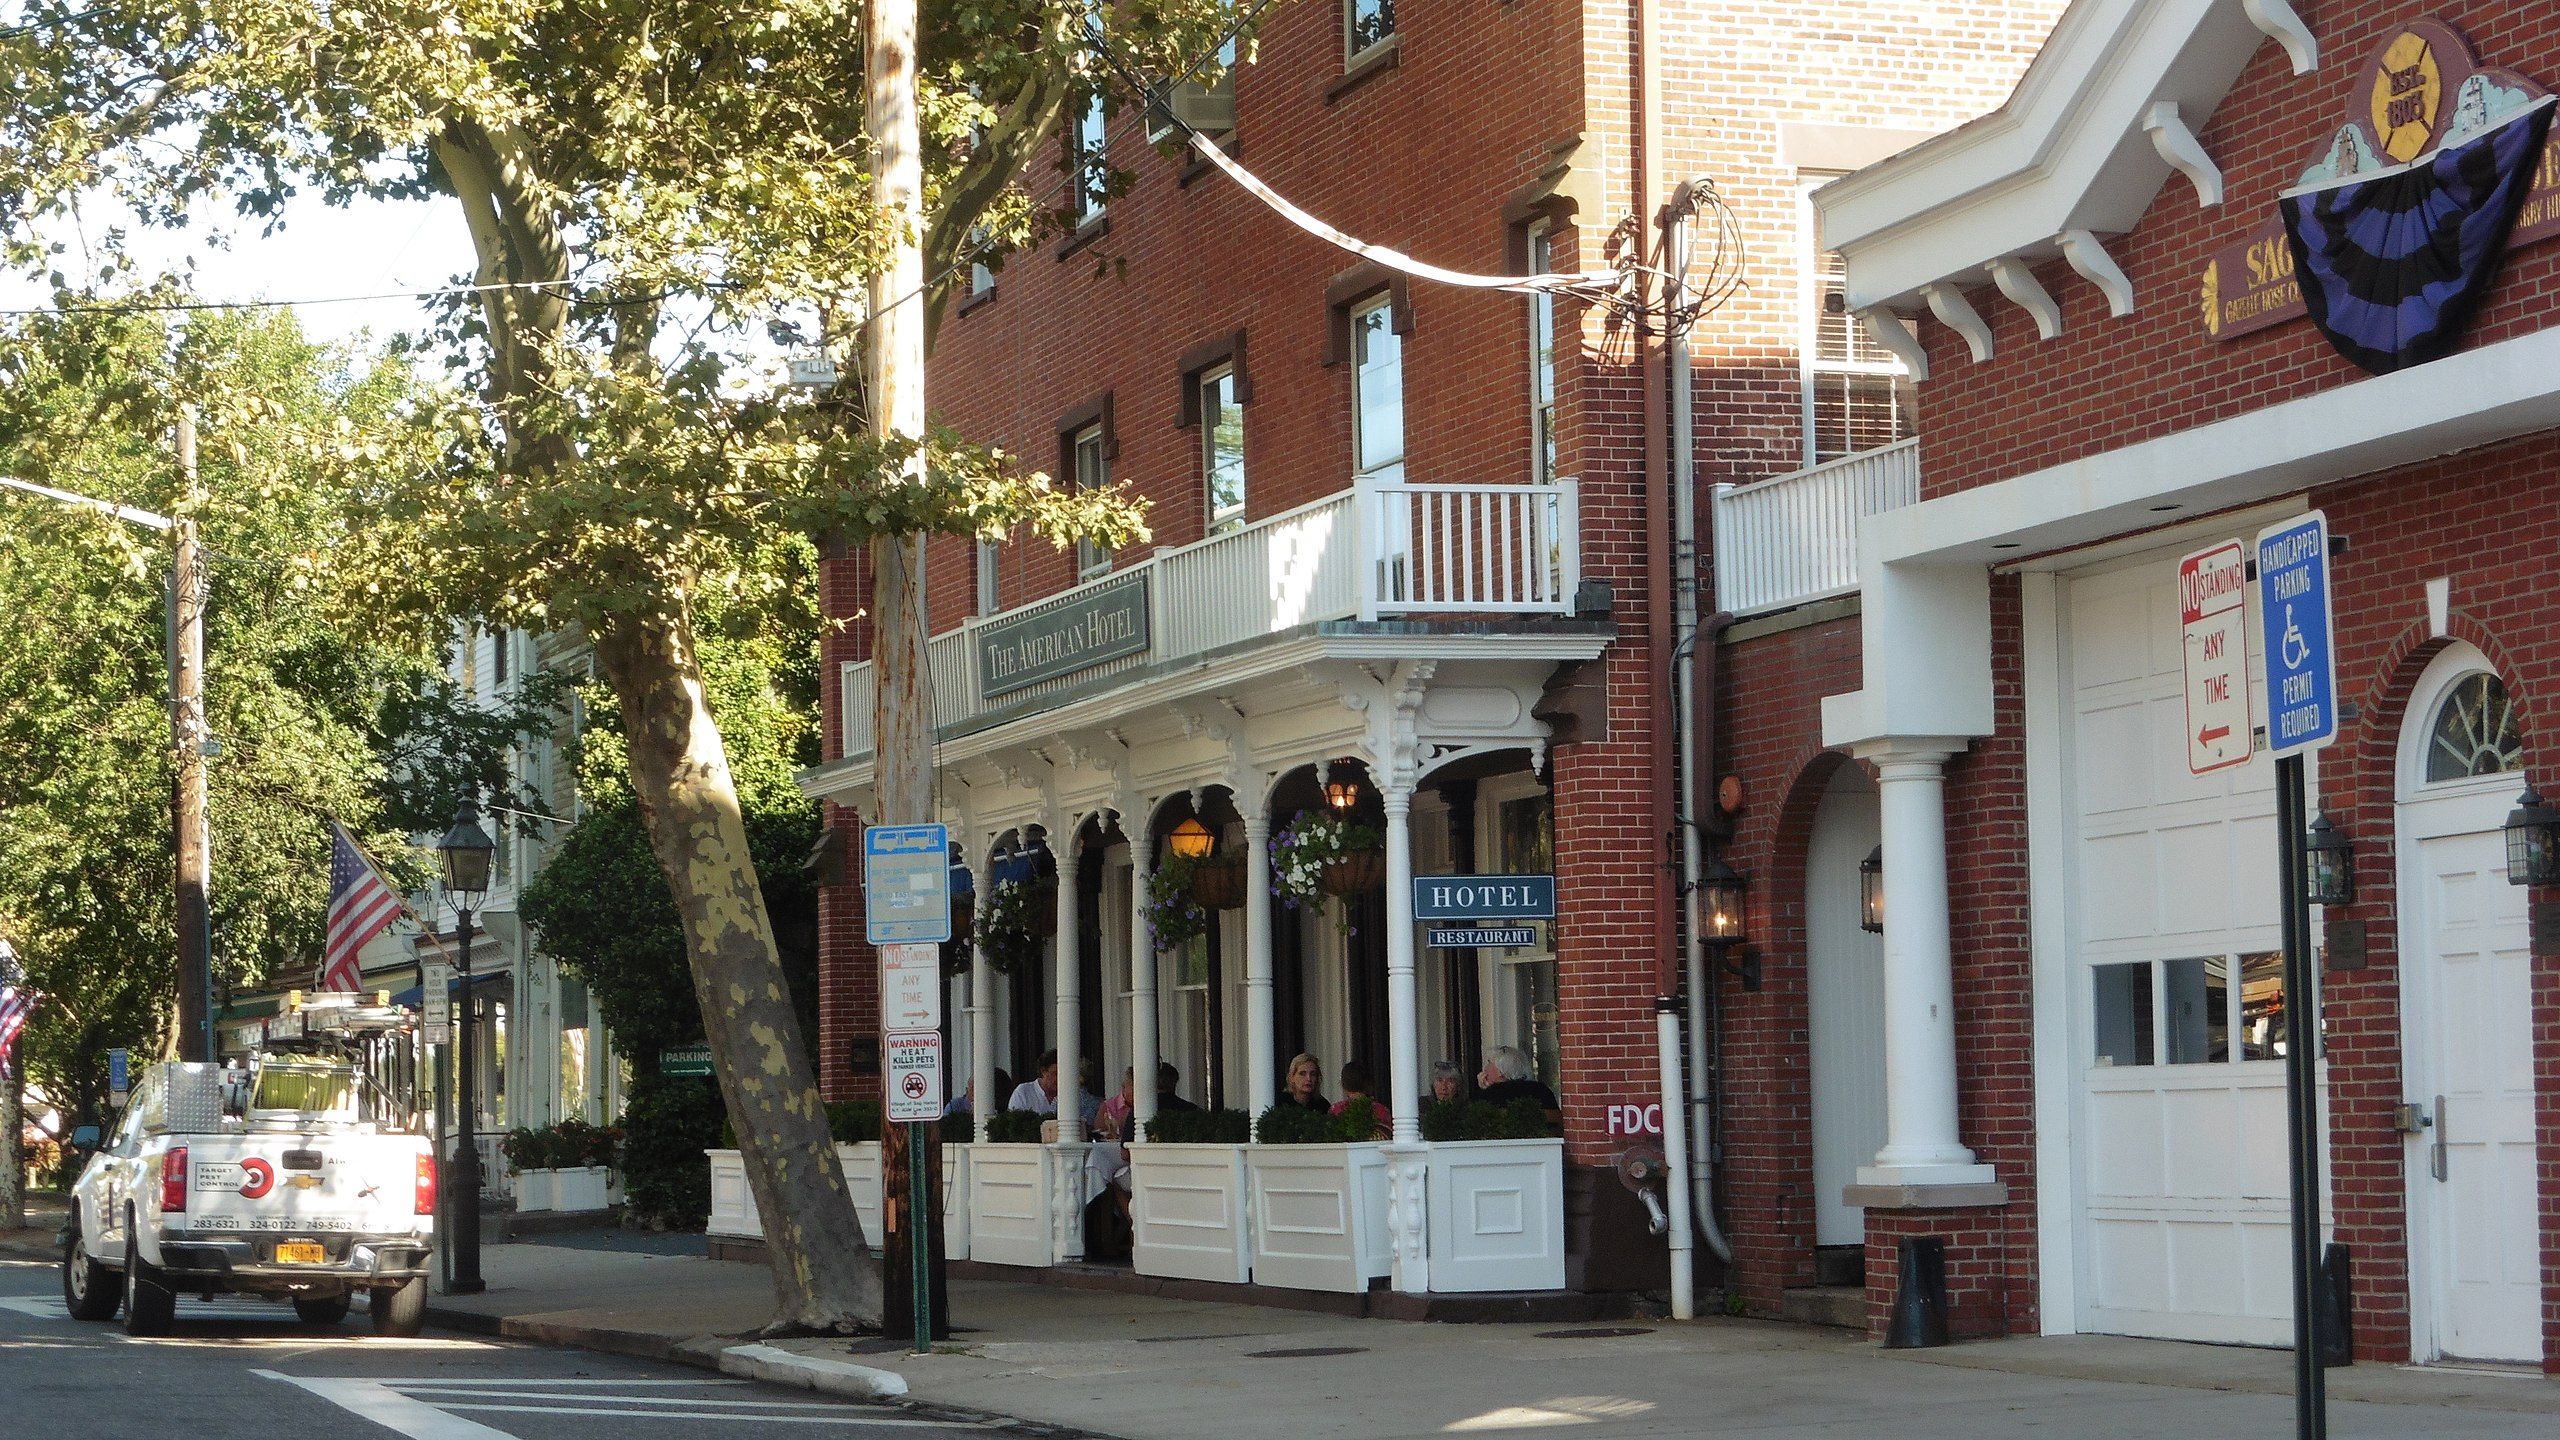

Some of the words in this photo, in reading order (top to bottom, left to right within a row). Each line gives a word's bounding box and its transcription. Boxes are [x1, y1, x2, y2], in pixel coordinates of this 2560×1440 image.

[2261, 528, 2320, 575] HANDICAPPED
[2181, 569, 2200, 614] NO
[2200, 563, 2242, 601] STANDING
[2273, 564, 2311, 603] PARKING
[987, 643, 1017, 680] THE
[1018, 622, 1084, 672] AMERICAN
[1086, 607, 1136, 649] HOTEL
[2203, 629, 2226, 662] ANY
[2203, 673, 2230, 705] TIME
[2282, 670, 2313, 707] PERMIT
[2280, 703, 2320, 739] REQUIRED
[1431, 886, 1538, 908] HOTEL
[1436, 930, 1530, 944] RESTAURANT
[886, 948, 900, 965] NO
[900, 950, 935, 962] STANDING
[902, 975, 921, 986] ANY
[902, 992, 922, 1003] TIME
[890, 1038, 937, 1048] WARNING
[901, 1048, 926, 1056] HEAT
[666, 1051, 713, 1063] PARKING
[893, 1056, 914, 1064] KILLS
[1608, 1103, 1661, 1134] FDC
[193, 1220, 240, 1229] 283-6321
[250, 1220, 297, 1229] 324-0122
[306, 1221, 352, 1230] 749-5402
